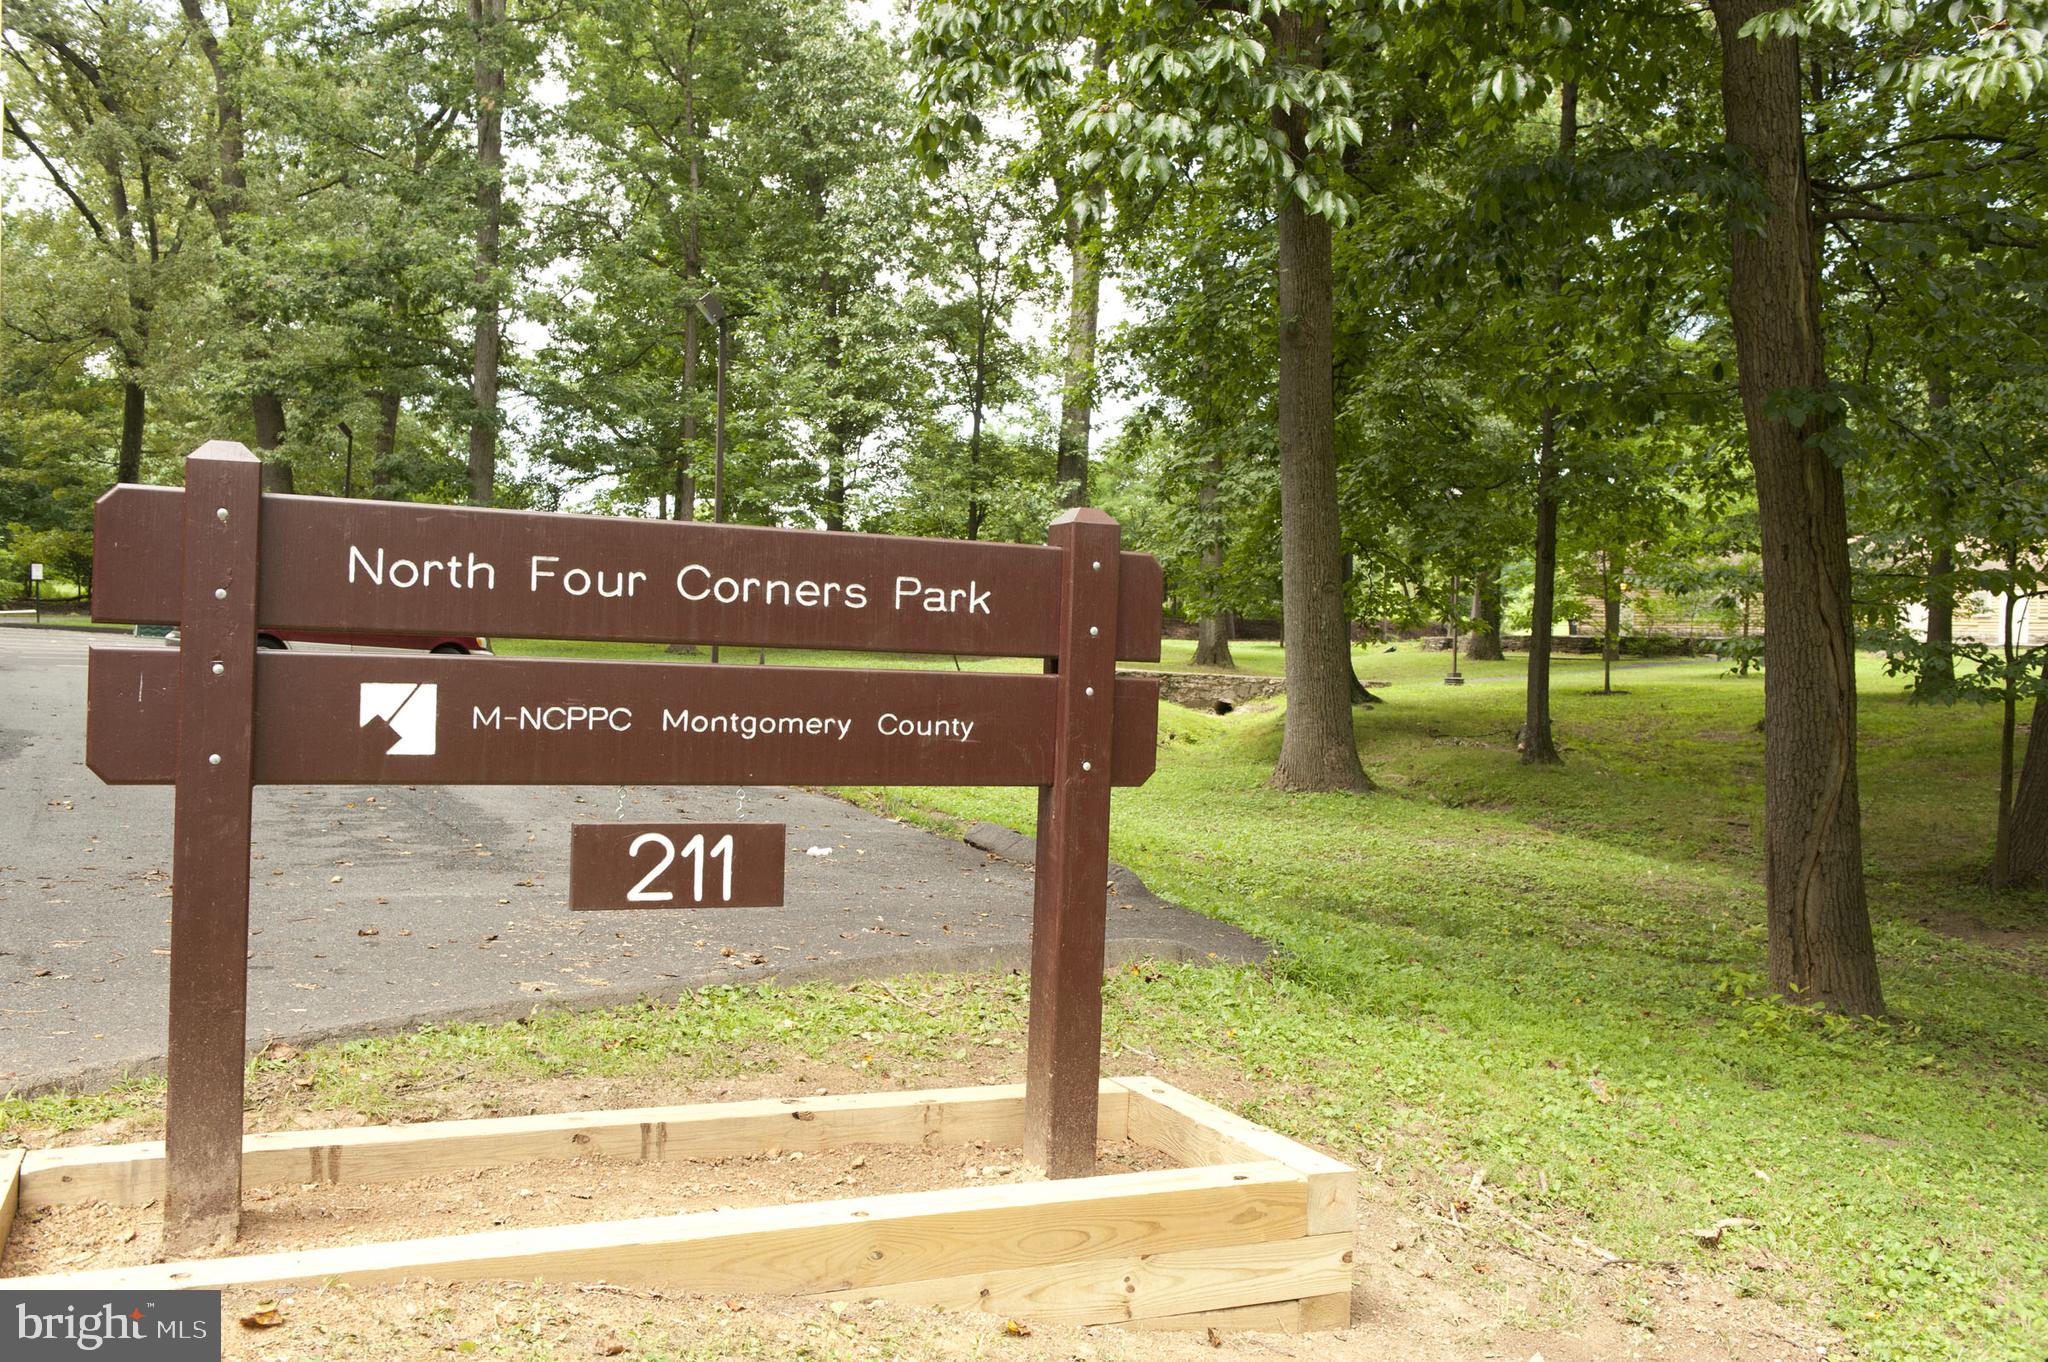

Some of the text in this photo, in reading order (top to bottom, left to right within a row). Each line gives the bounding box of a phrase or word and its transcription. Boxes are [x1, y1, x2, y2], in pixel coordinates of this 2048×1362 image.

[348, 545, 992, 615] North Four Corners Park
[472, 705, 974, 743] M-NCPPC Montgomery County
[626, 832, 734, 902] 211
